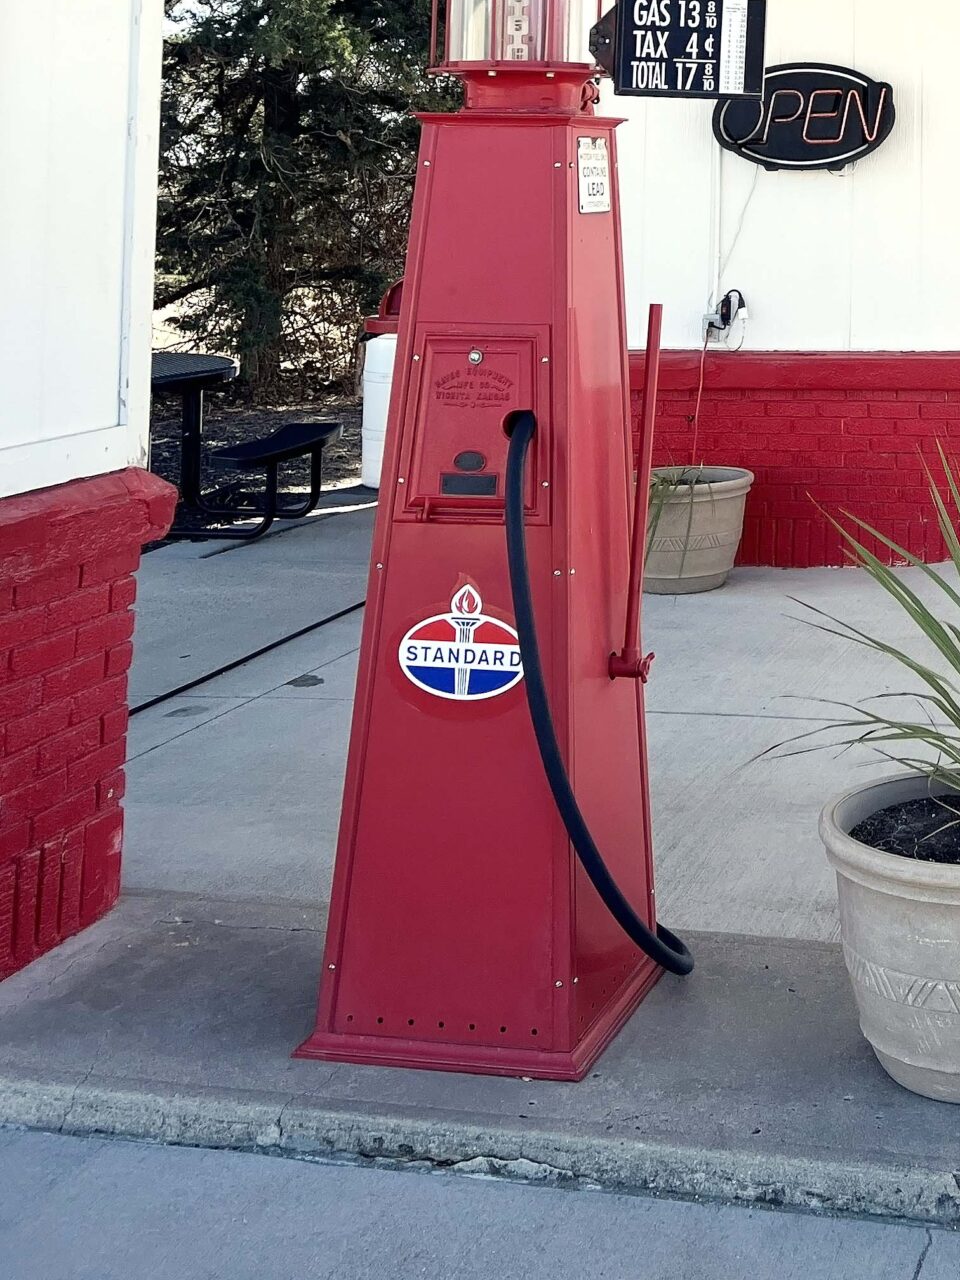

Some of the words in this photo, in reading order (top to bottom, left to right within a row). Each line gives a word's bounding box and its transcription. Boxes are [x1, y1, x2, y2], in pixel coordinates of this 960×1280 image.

[633, 0, 670, 27] GAS
[678, 0, 701, 28] 13
[633, 30, 669, 58] TAX
[686, 33, 698, 60] 4
[631, 61, 668, 89] TOTAL
[676, 63, 697, 90] 17
[720, 88, 887, 145] OPEN
[583, 166, 606, 178] CONTAINS
[587, 182, 604, 196] LEAD
[407, 645, 521, 667] STANDARD
